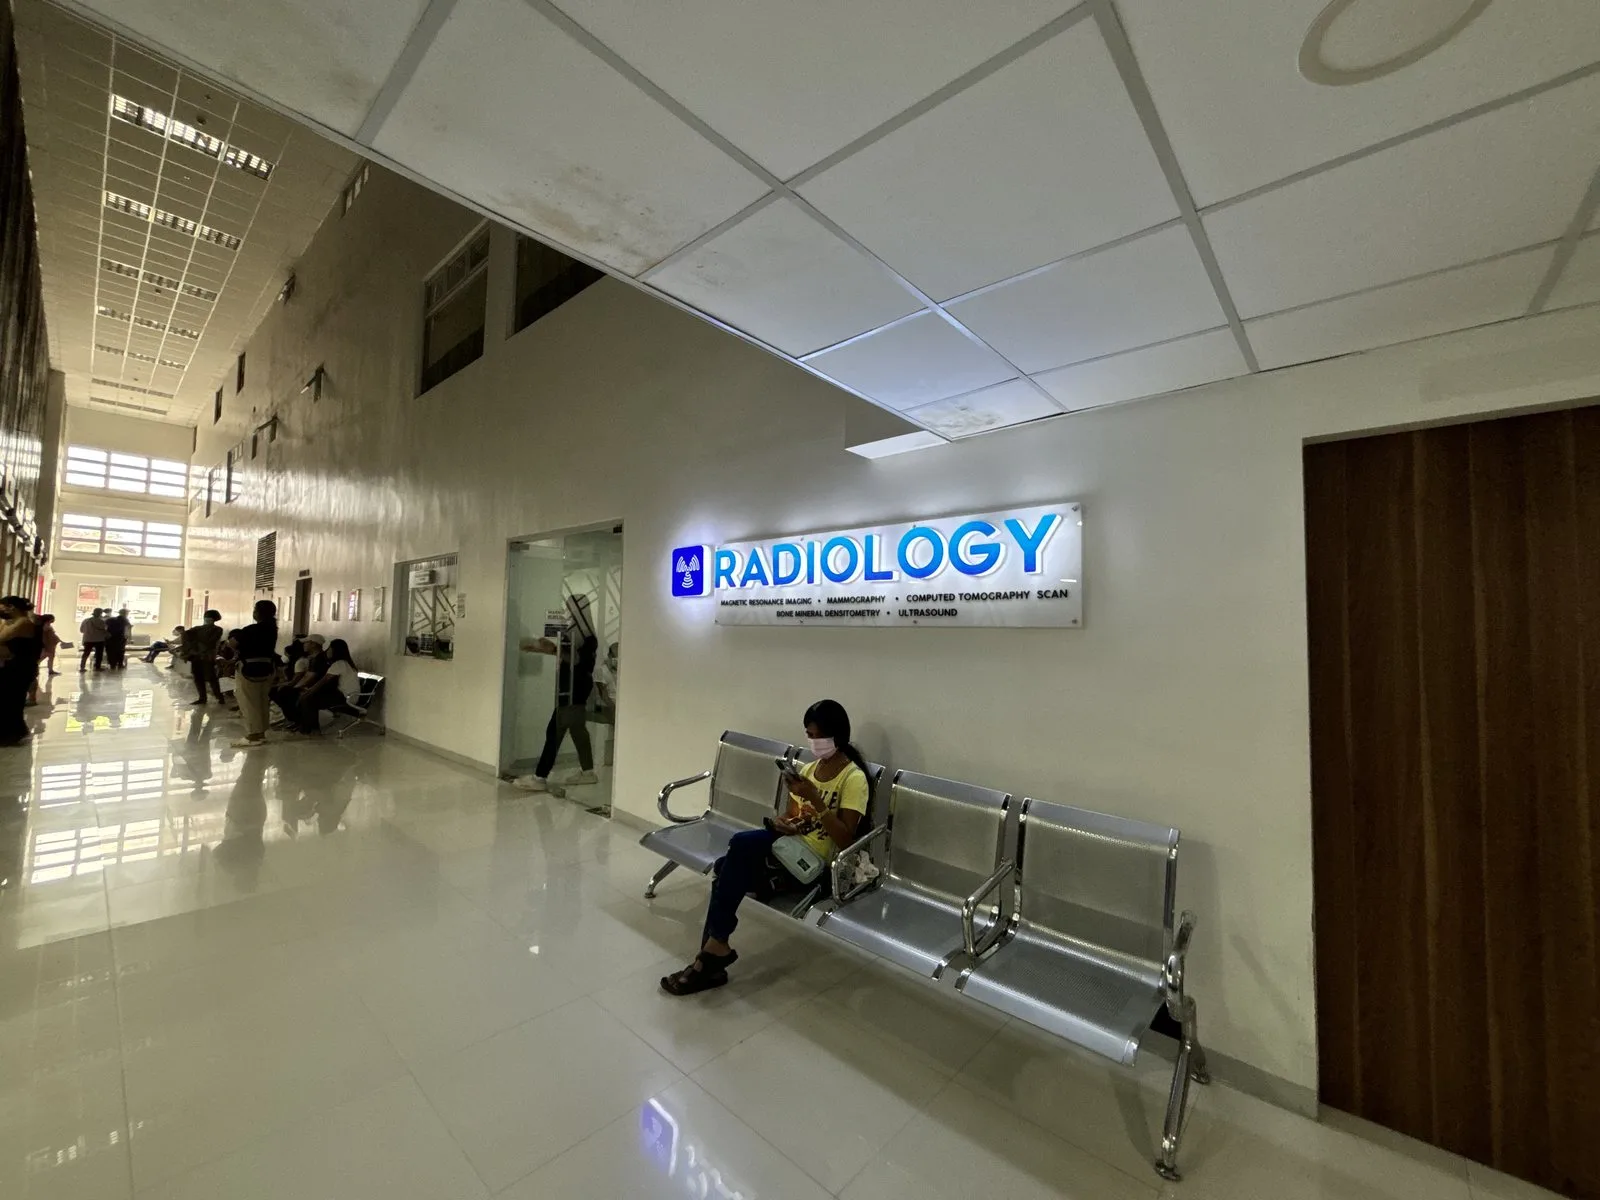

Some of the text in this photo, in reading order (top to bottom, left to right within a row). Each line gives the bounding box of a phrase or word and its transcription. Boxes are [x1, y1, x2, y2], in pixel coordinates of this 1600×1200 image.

[714, 513, 1058, 588] RADIOLOGY
[749, 598, 784, 606] RESONANCE
[785, 597, 812, 605] IMAGING
[826, 596, 886, 604] MAMMOGRAPHY
[906, 593, 956, 603] COMPUTED
[959, 590, 1031, 601] TOMOGRAPHY
[1037, 589, 1069, 599] SCAN
[776, 608, 958, 618] BONE MINERAL DENSITOMETRY ULTRASOUND
